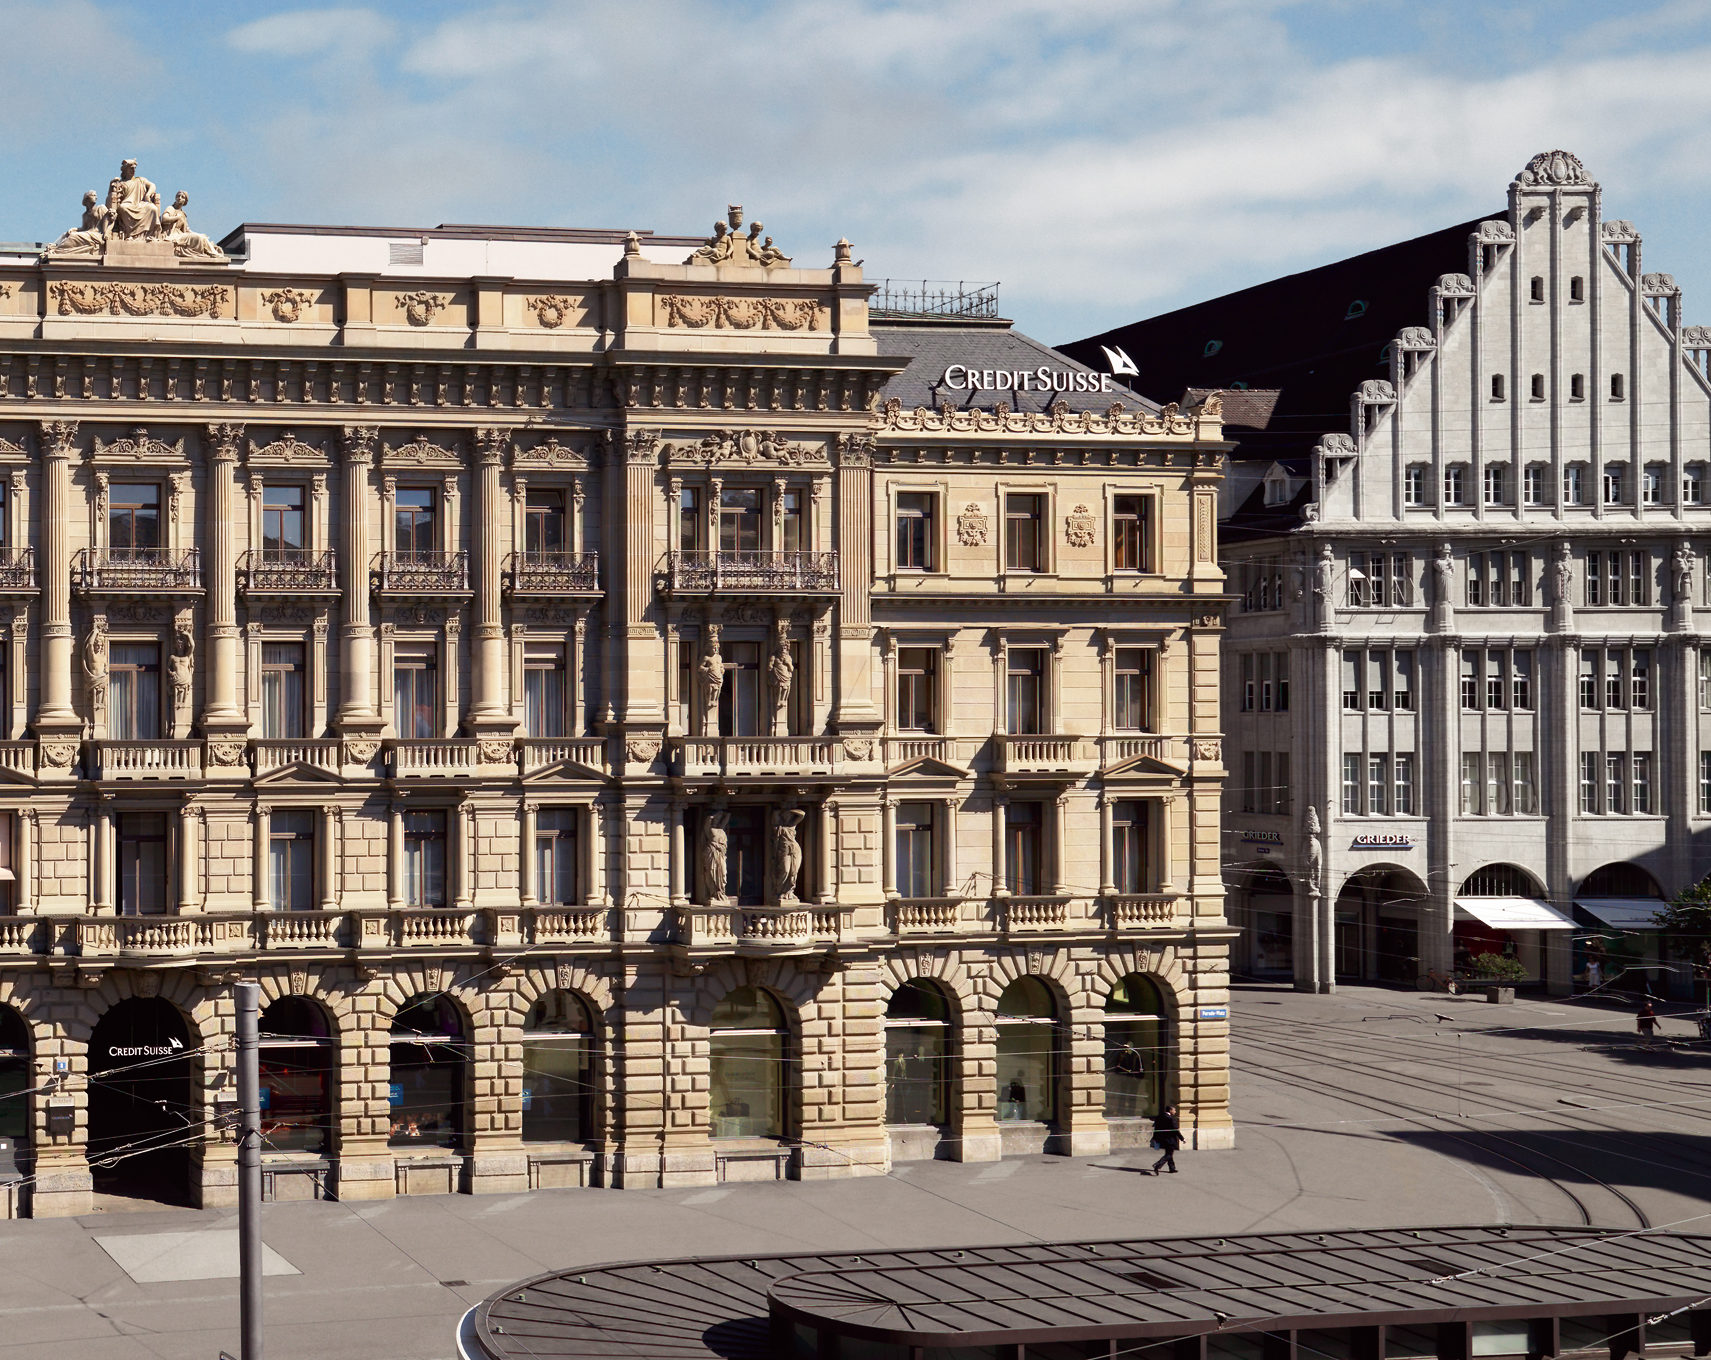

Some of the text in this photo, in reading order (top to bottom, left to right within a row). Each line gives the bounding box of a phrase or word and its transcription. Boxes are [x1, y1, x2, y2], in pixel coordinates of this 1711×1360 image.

[944, 364, 1113, 393] CREDIT SUISSE
[1242, 831, 1280, 841] GRIEDER
[1356, 834, 1411, 845] GRIEDER
[108, 1045, 173, 1057] CREDIT SUISSE
